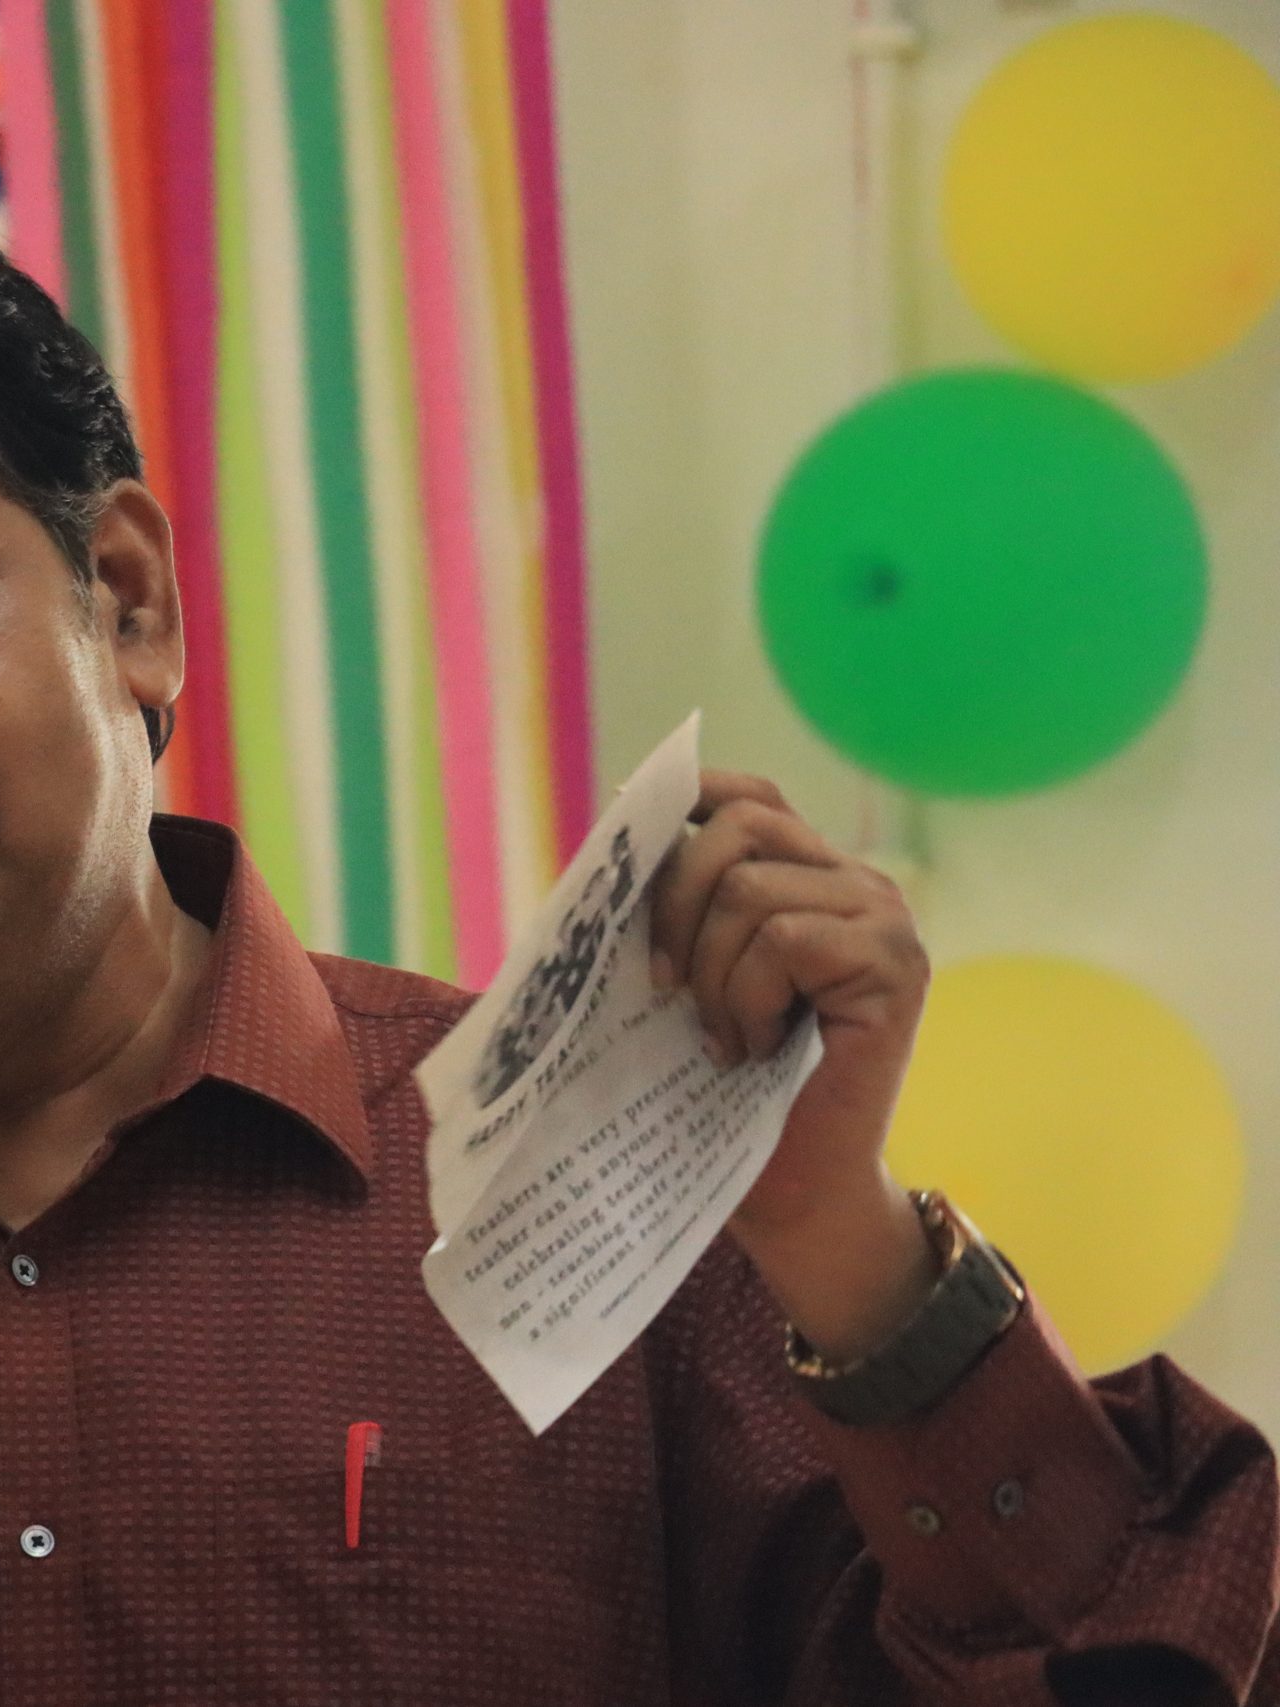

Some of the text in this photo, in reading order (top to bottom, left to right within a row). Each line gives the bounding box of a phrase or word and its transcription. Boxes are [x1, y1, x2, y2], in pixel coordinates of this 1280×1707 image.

[466, 1056, 699, 1244] Teachers are very precious
[464, 1227, 529, 1283] teacher
[535, 1199, 568, 1229] can
[568, 1176, 594, 1201] be
[598, 1124, 660, 1179] anyone
[503, 1206, 606, 1291] celebrating
[543, 1240, 636, 1328] significant
[548, 1222, 625, 1288] teaching
